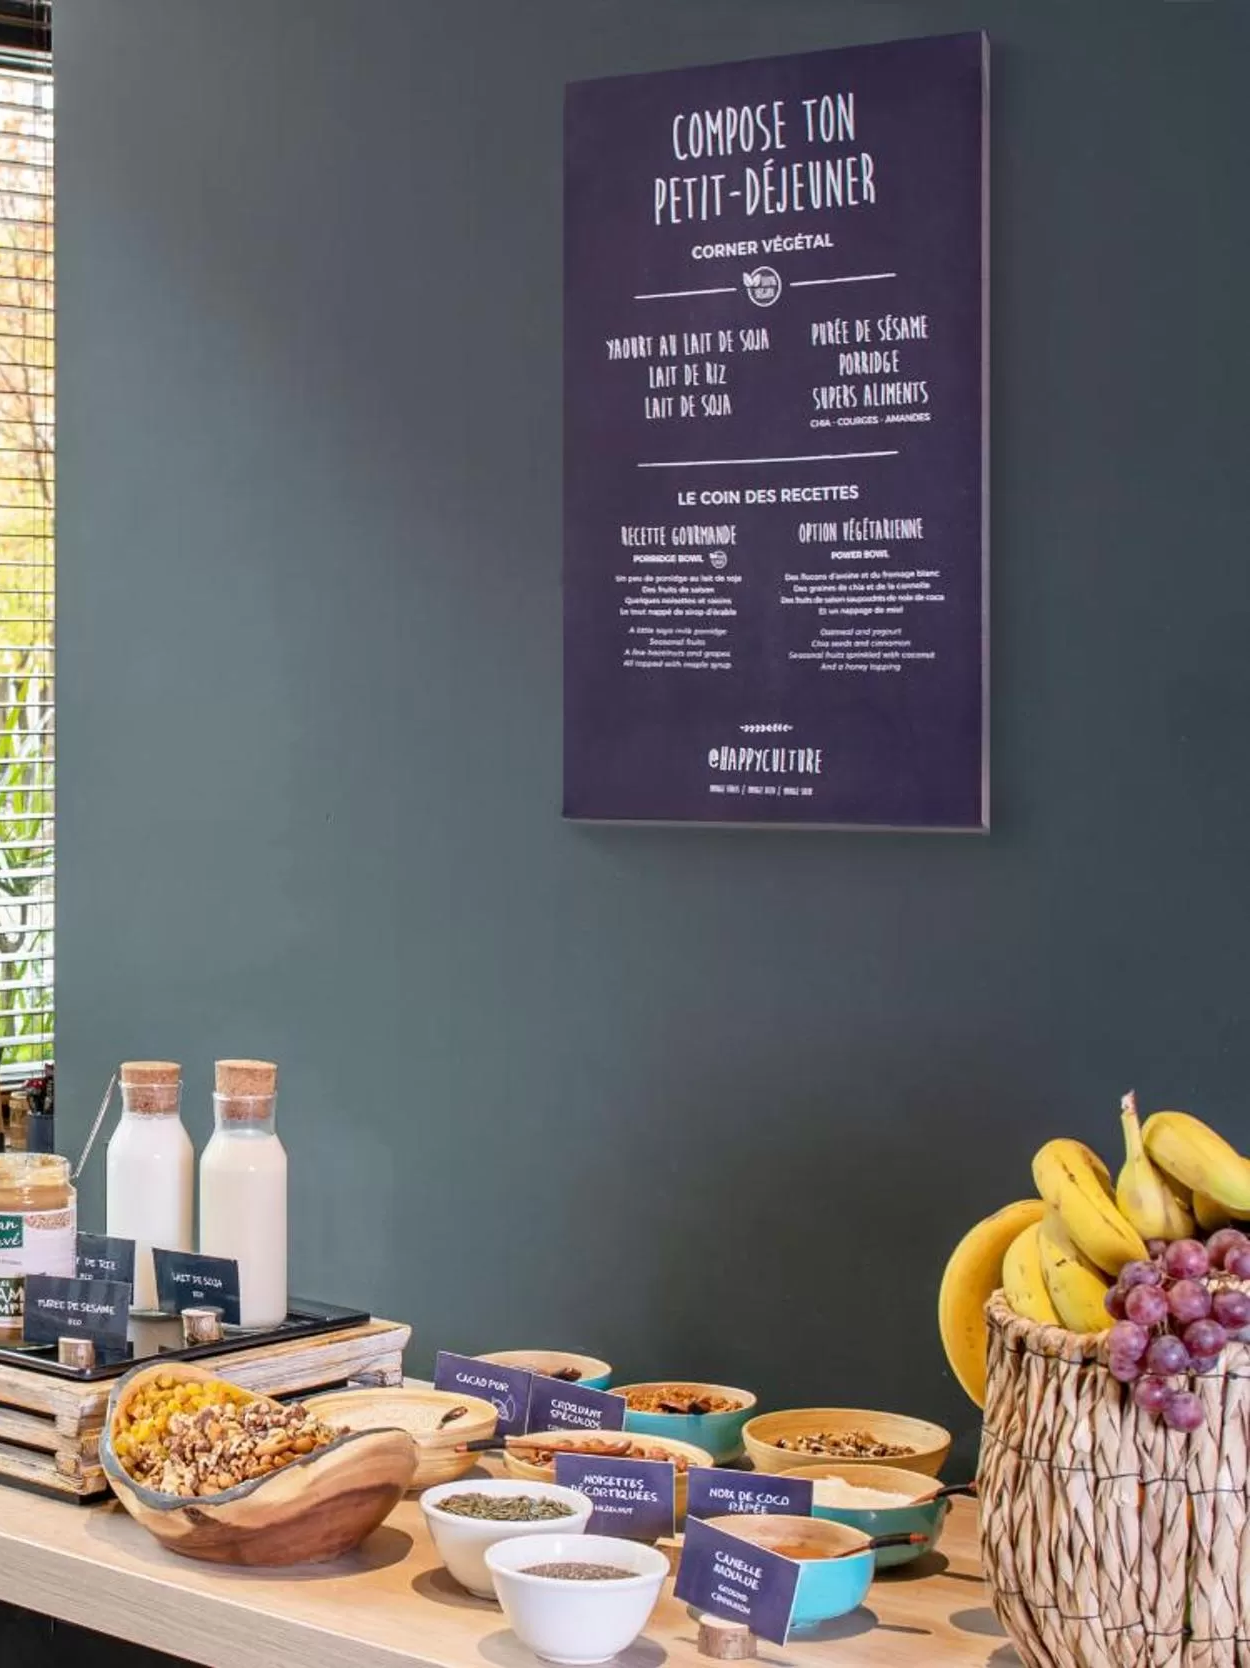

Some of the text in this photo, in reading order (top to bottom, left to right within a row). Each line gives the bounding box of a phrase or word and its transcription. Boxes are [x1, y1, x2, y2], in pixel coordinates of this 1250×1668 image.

[672, 92, 855, 161] COMPOSE TON
[654, 152, 876, 226] PETIT-DÉJEUNER
[691, 233, 834, 259] CORNER VÉGÉTAL
[811, 314, 928, 346] PURÉE DE SÉSAME
[606, 328, 770, 360] YAOURT AU LAIT DE SOJA
[649, 361, 727, 389] LAIT DE RIZ
[839, 349, 900, 376] PORRIDGE
[644, 393, 731, 419] LAIT DE SOJA
[812, 381, 928, 410] SUPERS ALIMENTS
[678, 485, 859, 506] LE COIN DES RECETTES
[621, 524, 737, 546] RECETTE GOURMANDE
[798, 517, 924, 543] OPTION VÉGÉTARIENNE
[831, 550, 890, 560] POWER BOWL
[708, 746, 822, 774] @HAPPYCULTURE
[67, 1301, 79, 1311] DE
[455, 1372, 510, 1393] CACAO PUR
[550, 1399, 603, 1419] CROQUANT
[583, 1474, 645, 1490] NOISETTES
[709, 1487, 790, 1506] NOIX DE COCO
[713, 1562, 760, 1591] MOULUE
